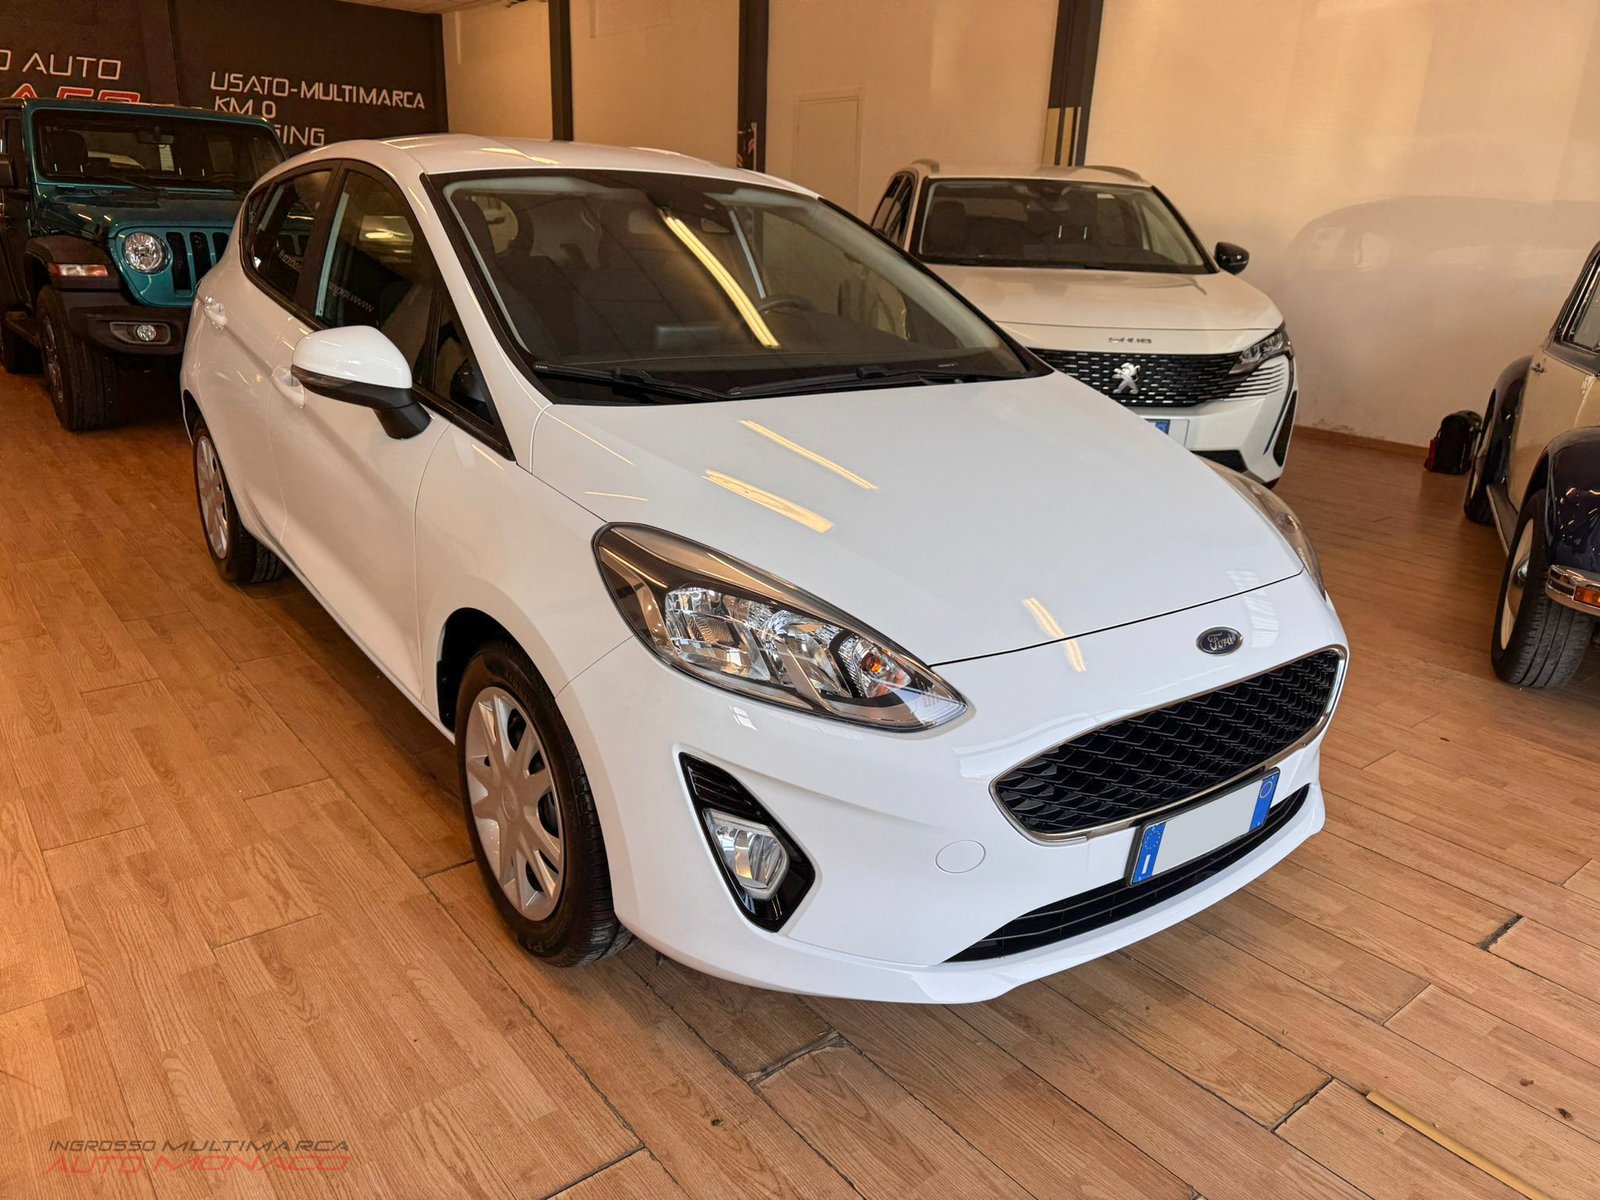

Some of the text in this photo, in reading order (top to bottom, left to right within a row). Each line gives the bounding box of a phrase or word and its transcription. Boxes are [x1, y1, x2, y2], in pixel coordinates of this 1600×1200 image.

[22, 52, 121, 80] AUTO
[210, 71, 426, 112] USATO-MULTIMARCA
[214, 96, 254, 116] KM
[1207, 632, 1234, 651] Ford
